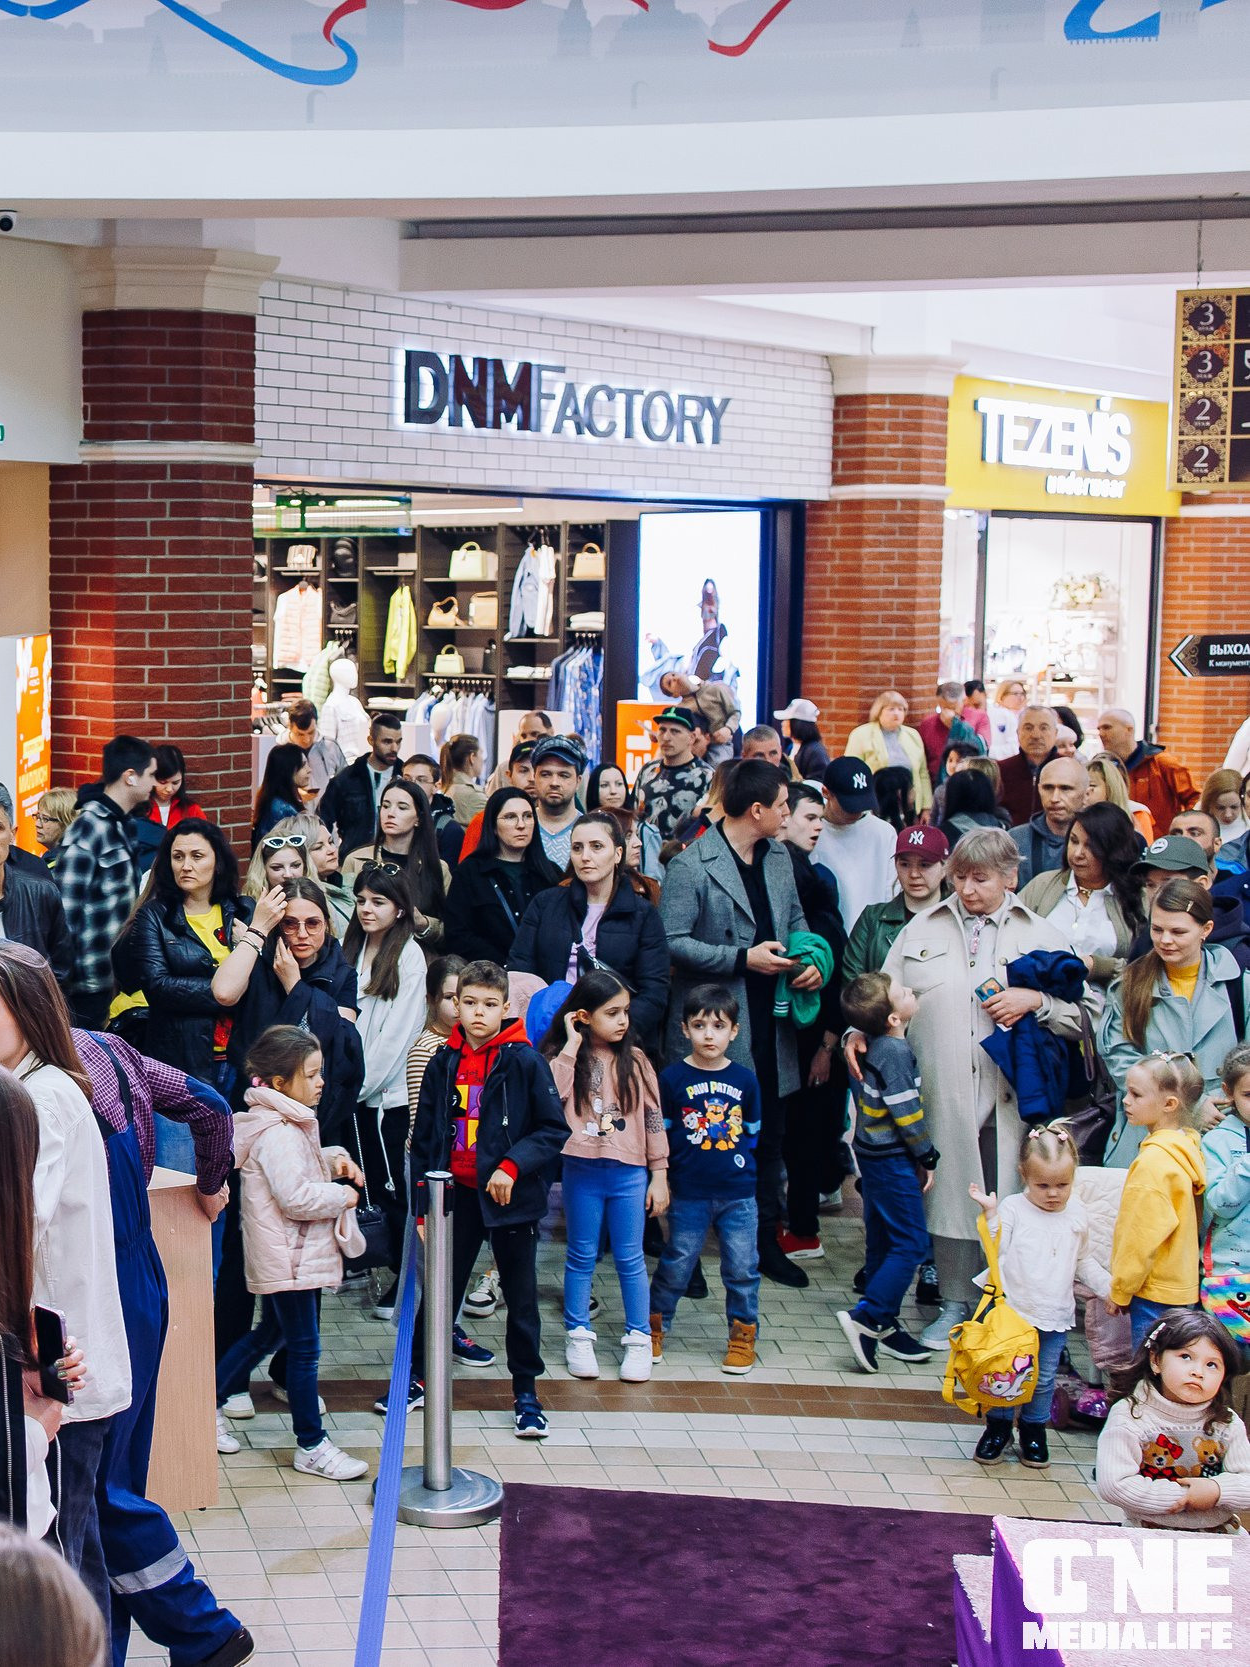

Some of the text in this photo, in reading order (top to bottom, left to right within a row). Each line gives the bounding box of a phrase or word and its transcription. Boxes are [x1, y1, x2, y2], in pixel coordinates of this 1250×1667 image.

[1199, 303, 1215, 326] 3
[1197, 350, 1213, 374] 3
[1194, 398, 1211, 421] 2
[1193, 445, 1209, 468] 2
[908, 830, 925, 845] NY
[686, 1080, 743, 1101] PAW PATROL
